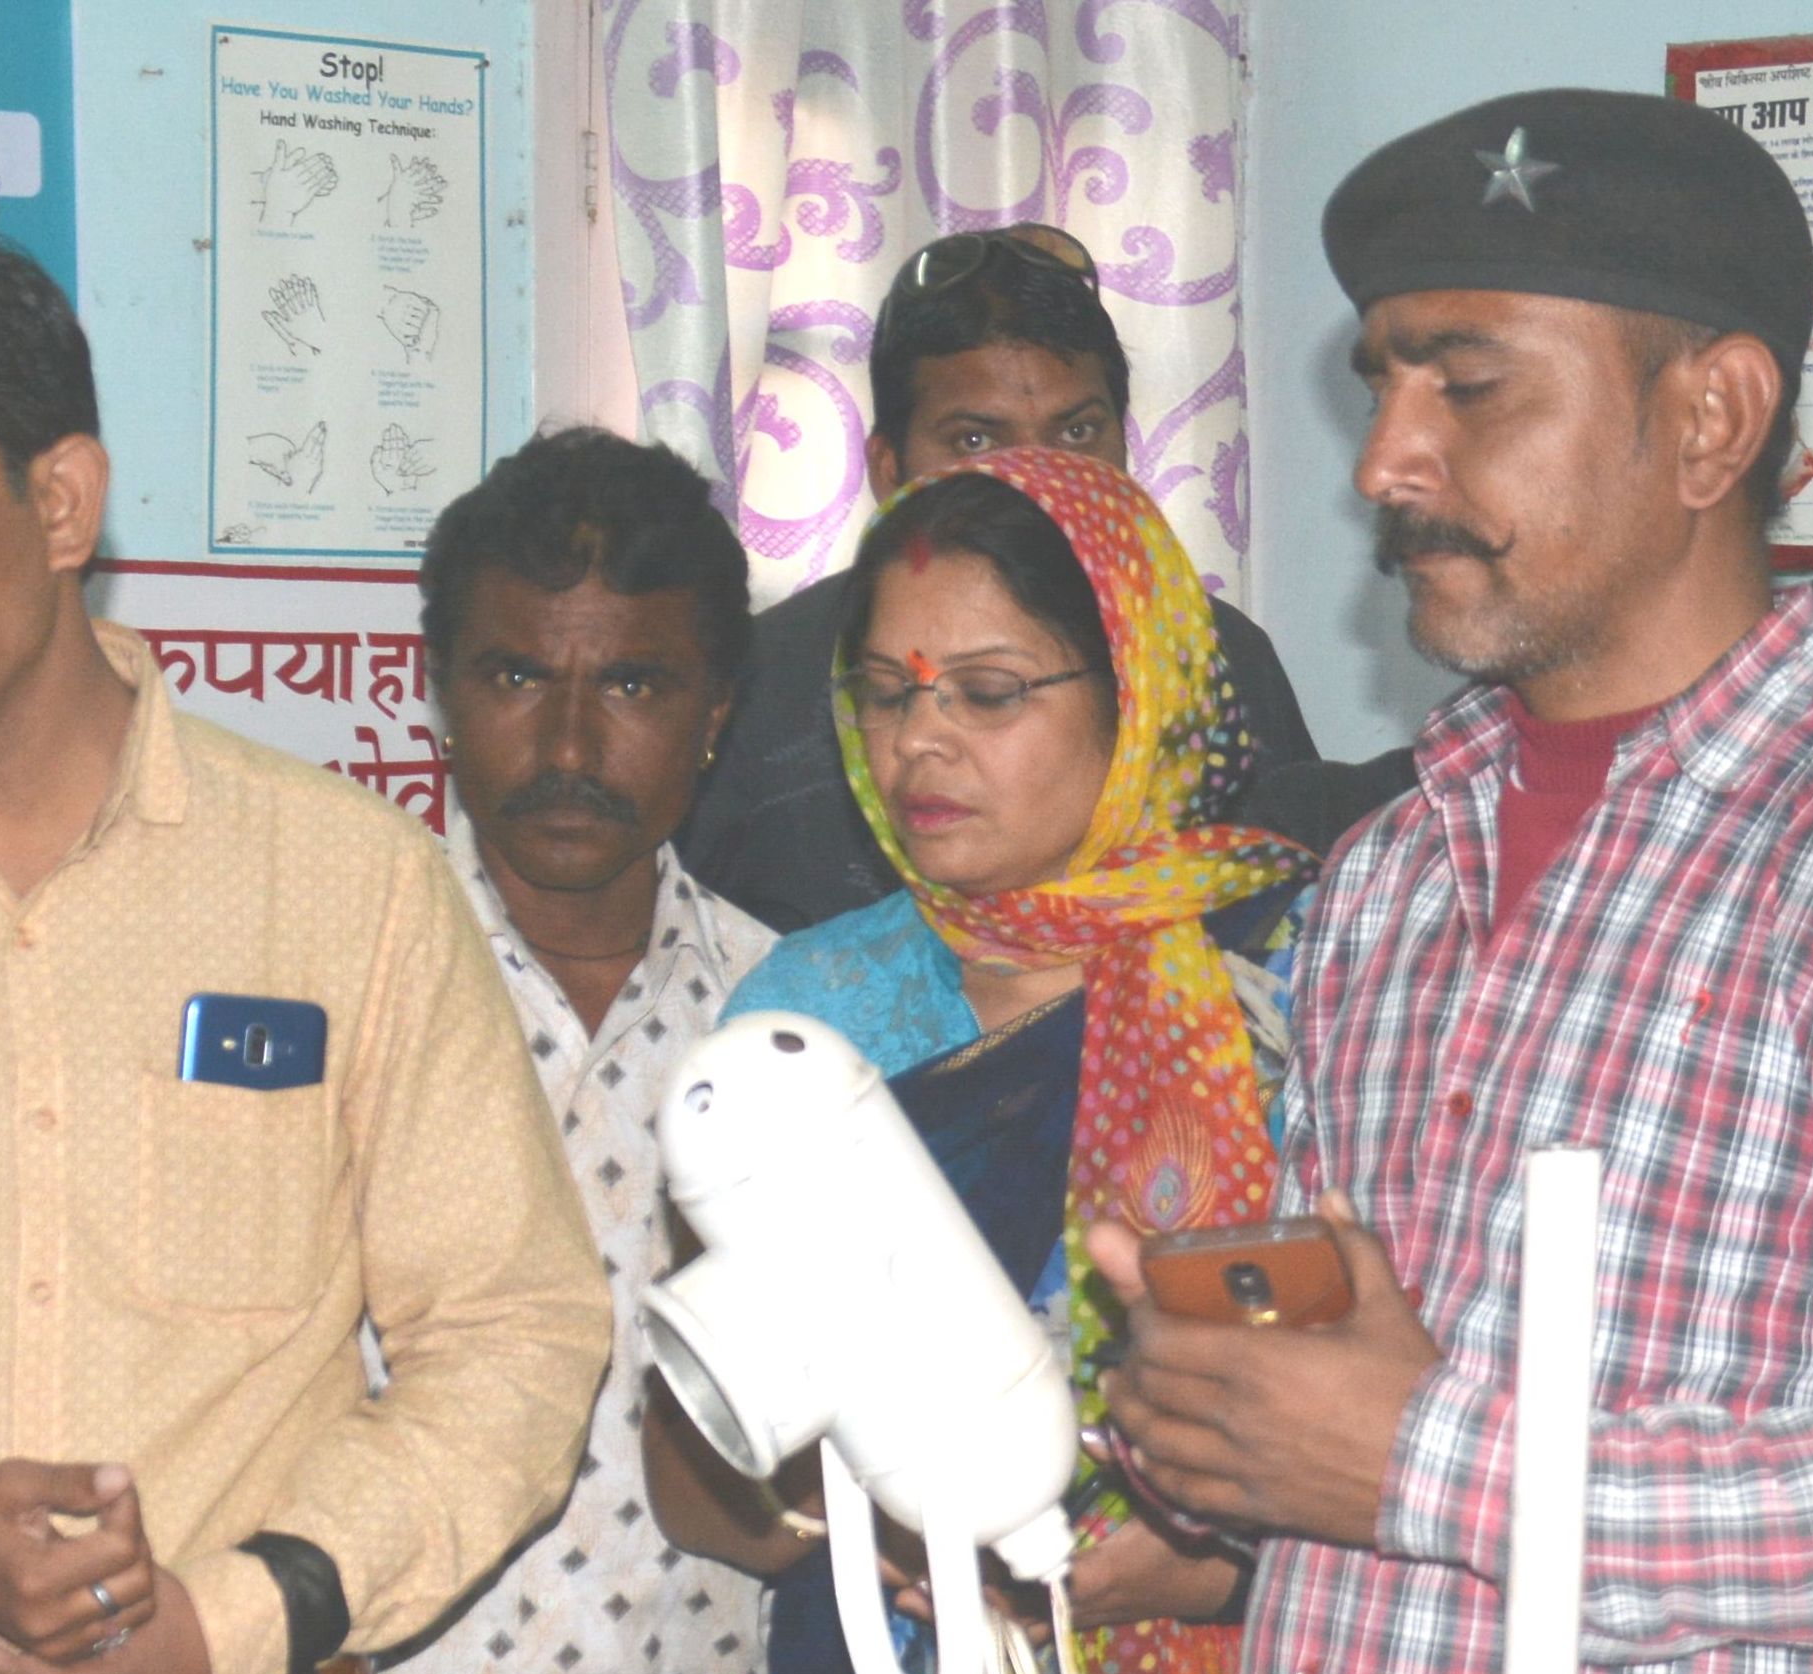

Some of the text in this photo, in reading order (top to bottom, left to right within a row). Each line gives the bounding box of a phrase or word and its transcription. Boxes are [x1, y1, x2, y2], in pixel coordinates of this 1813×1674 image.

[319, 52, 384, 90] Stop!
[220, 76, 475, 116] Have You Washed Your Hands?
[1751, 97, 1810, 130] आप
[260, 110, 437, 141] Hand Washing Technique:
